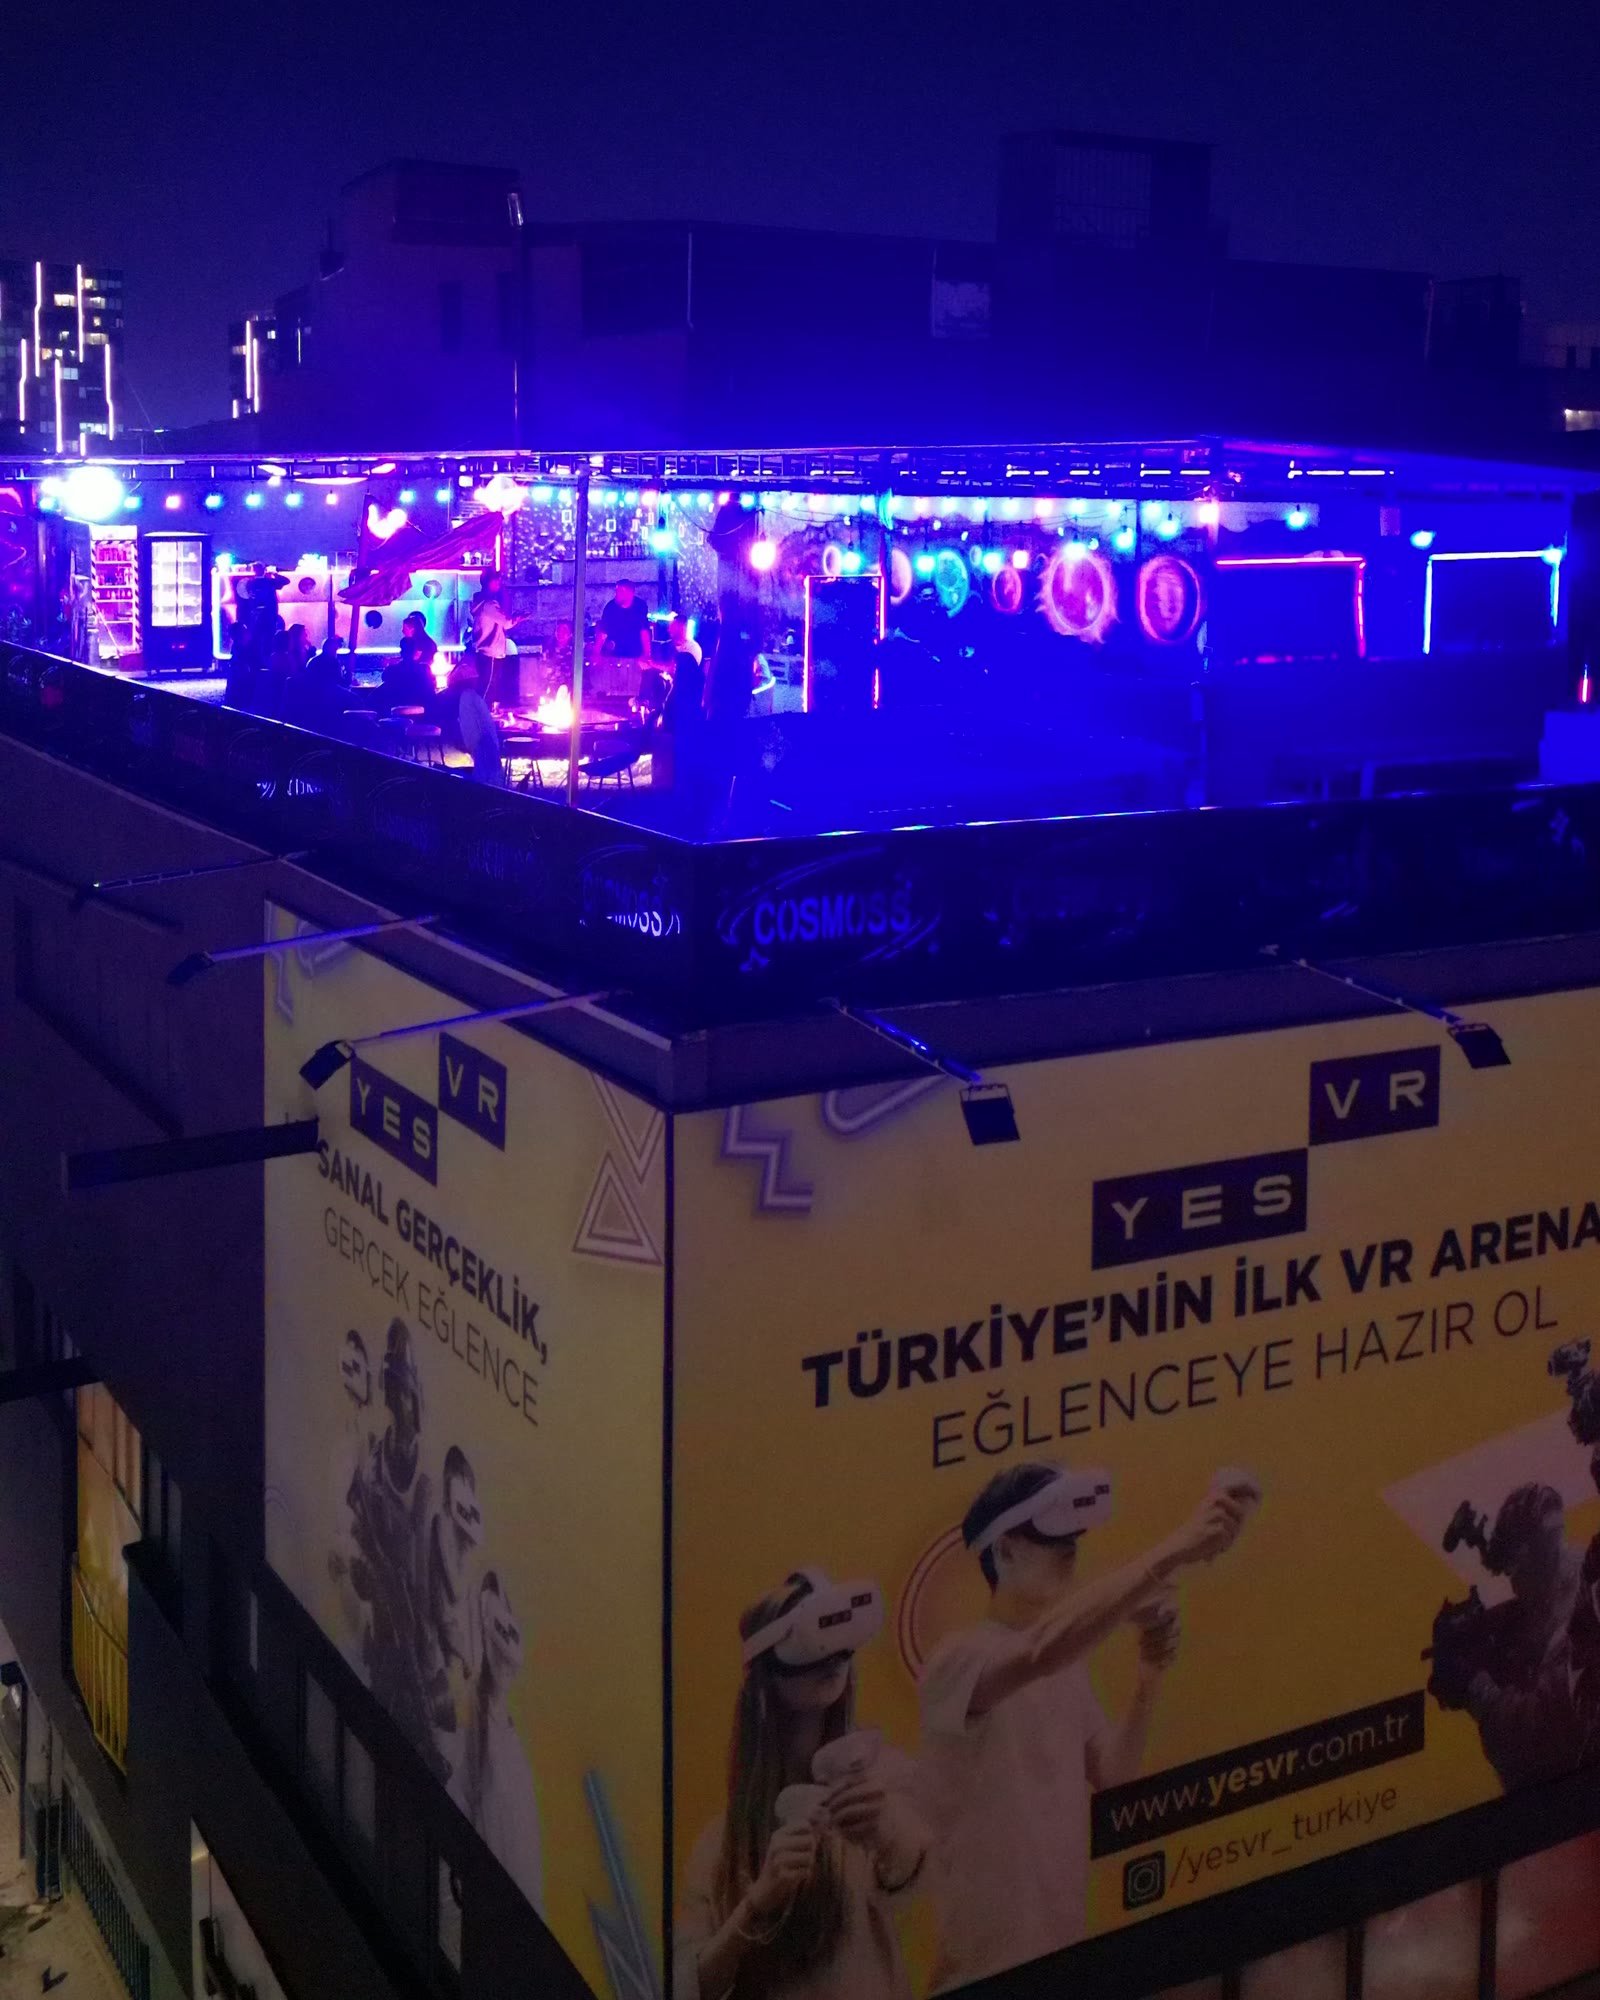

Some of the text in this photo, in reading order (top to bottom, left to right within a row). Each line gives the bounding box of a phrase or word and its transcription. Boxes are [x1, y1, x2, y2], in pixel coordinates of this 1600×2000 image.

[754, 891, 911, 945] COSMOSS
[357, 1078, 430, 1159] YES
[446, 1056, 499, 1123] VR
[1324, 1069, 1426, 1119] VR
[318, 1139, 547, 1365] SANAL GERÇEKLİK,
[1110, 1174, 1293, 1240] YES
[324, 1207, 538, 1427] GERÇEK EĞLENCE
[802, 1201, 1600, 1409] TÜRKİYE'NİN İLK VR ARENA
[933, 1286, 1558, 1468] EĞLENCEYE HAZIR OL
[1110, 1711, 1409, 1832] www.yesvr.com.tr
[1168, 1787, 1399, 1889] /yesvr_turkiye
